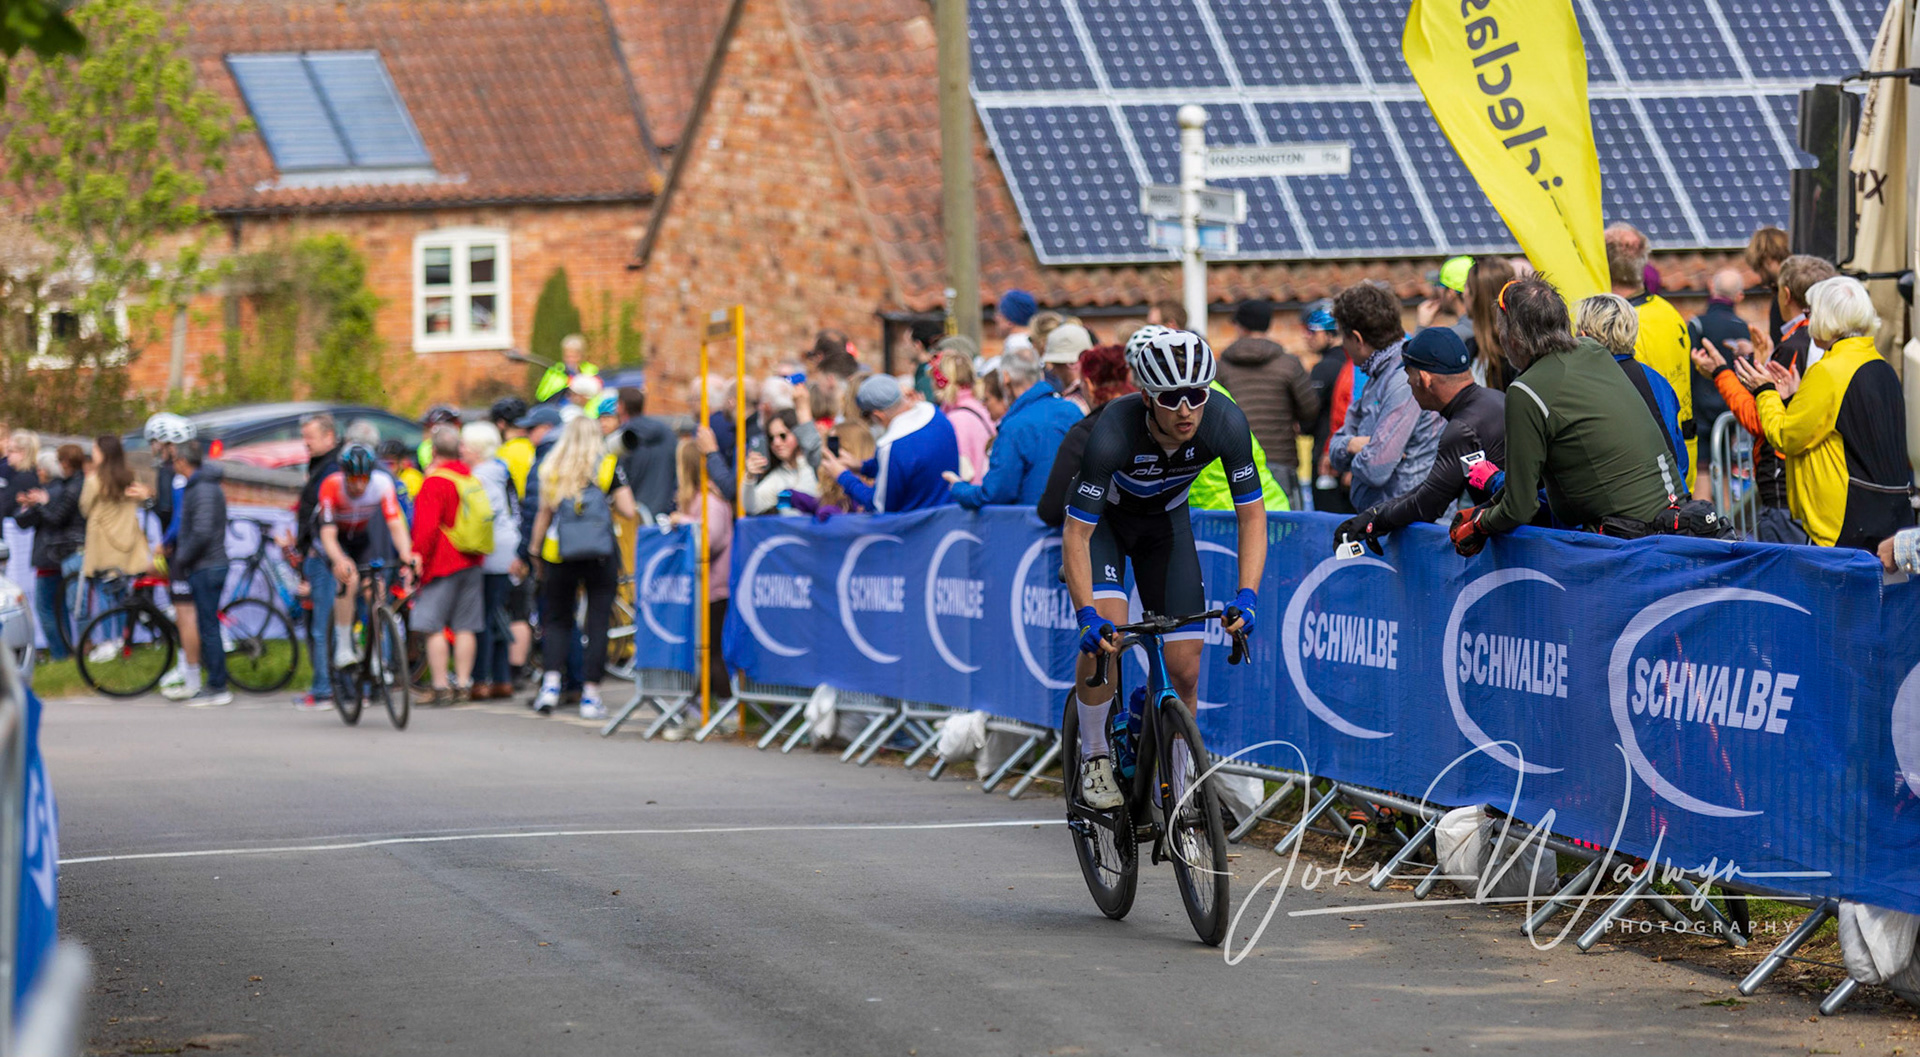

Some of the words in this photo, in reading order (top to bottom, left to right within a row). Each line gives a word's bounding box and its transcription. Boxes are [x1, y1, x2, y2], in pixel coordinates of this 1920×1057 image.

[850, 575, 905, 613] SCHWALBE
[935, 577, 985, 620] SCHWALBE
[1023, 584, 1080, 630] SCHWAL
[1302, 610, 1398, 670] SCHWALBE
[1459, 630, 1568, 698] SCHWALBE
[1631, 657, 1800, 734] SCHWALBE
